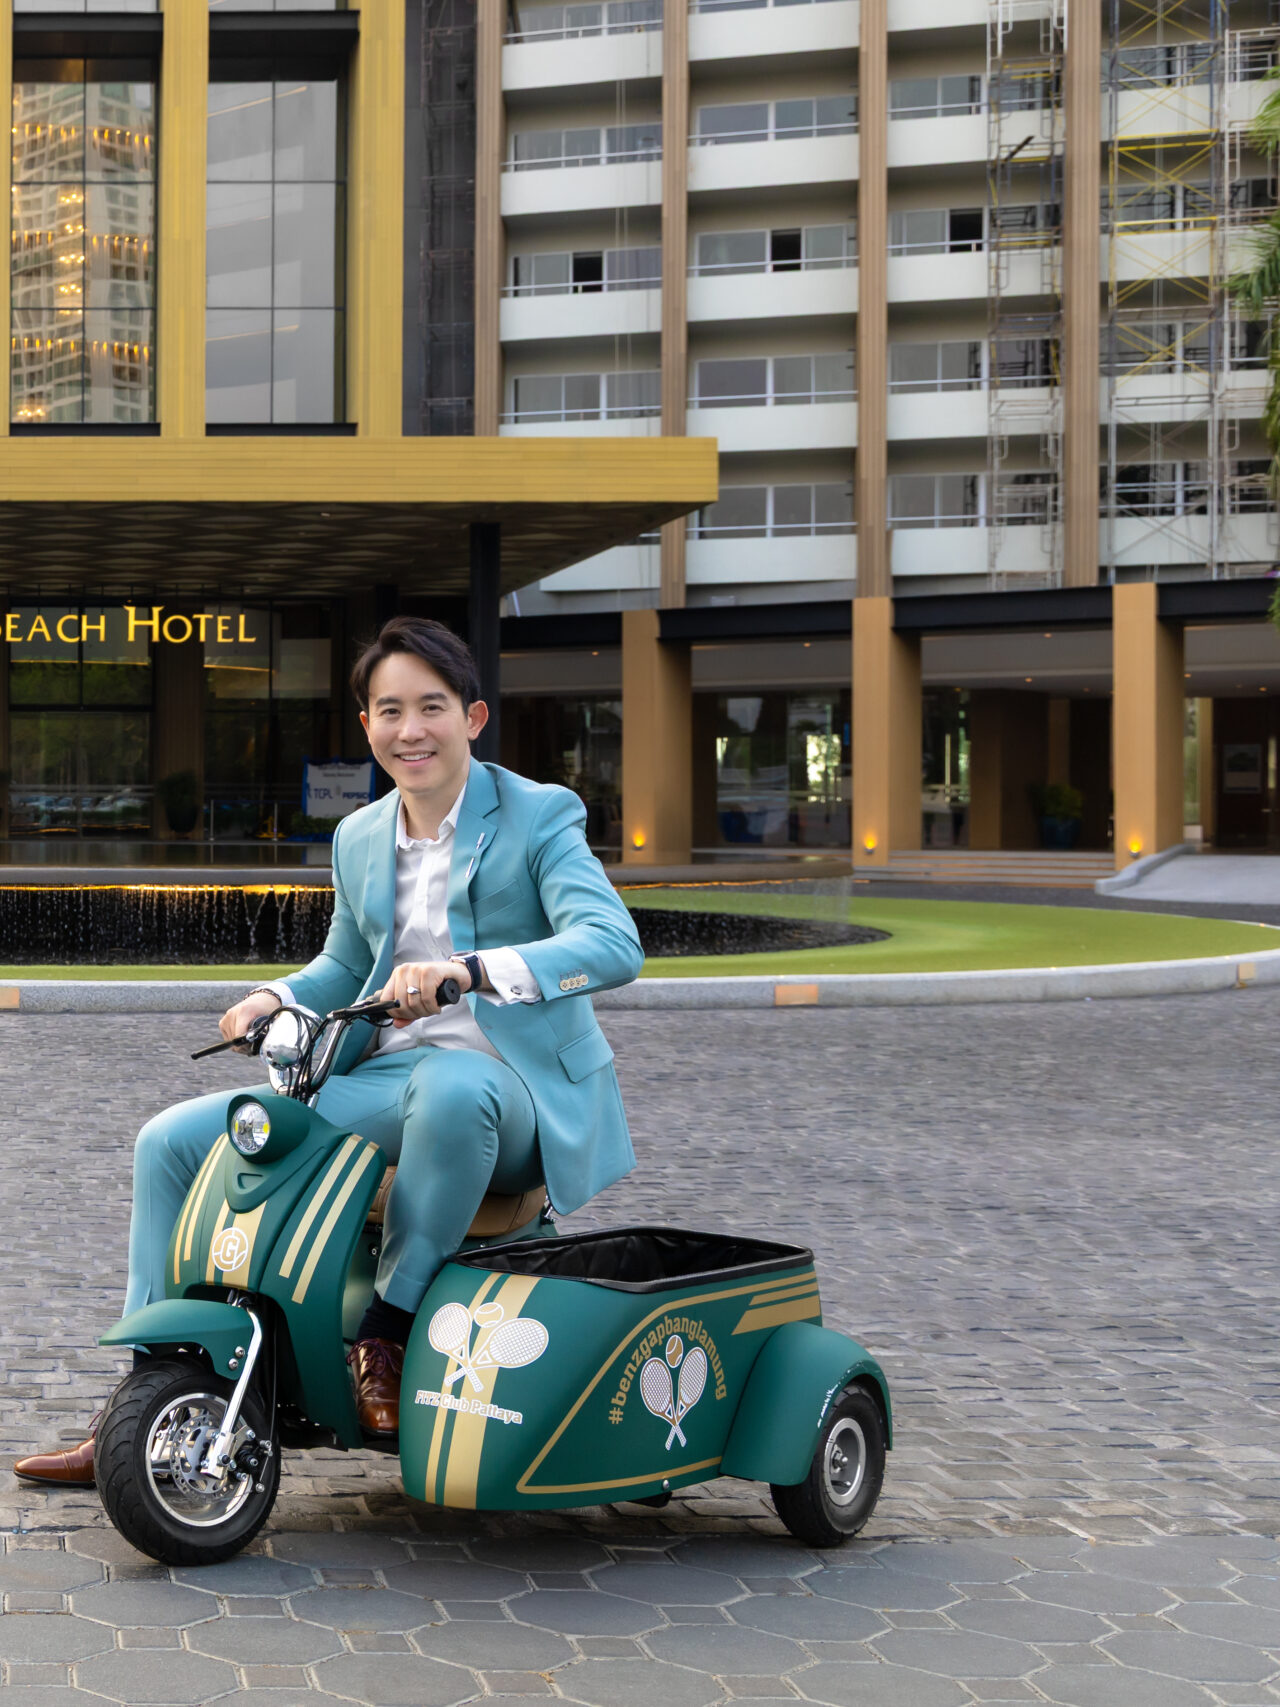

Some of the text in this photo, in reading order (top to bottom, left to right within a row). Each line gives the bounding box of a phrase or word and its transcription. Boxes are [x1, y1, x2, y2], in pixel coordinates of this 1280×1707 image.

[123, 605, 256, 642] HOTEL
[608, 1315, 727, 1425] #benzgapbanglamung
[415, 1390, 523, 1424] FITZ Club Pattaya
